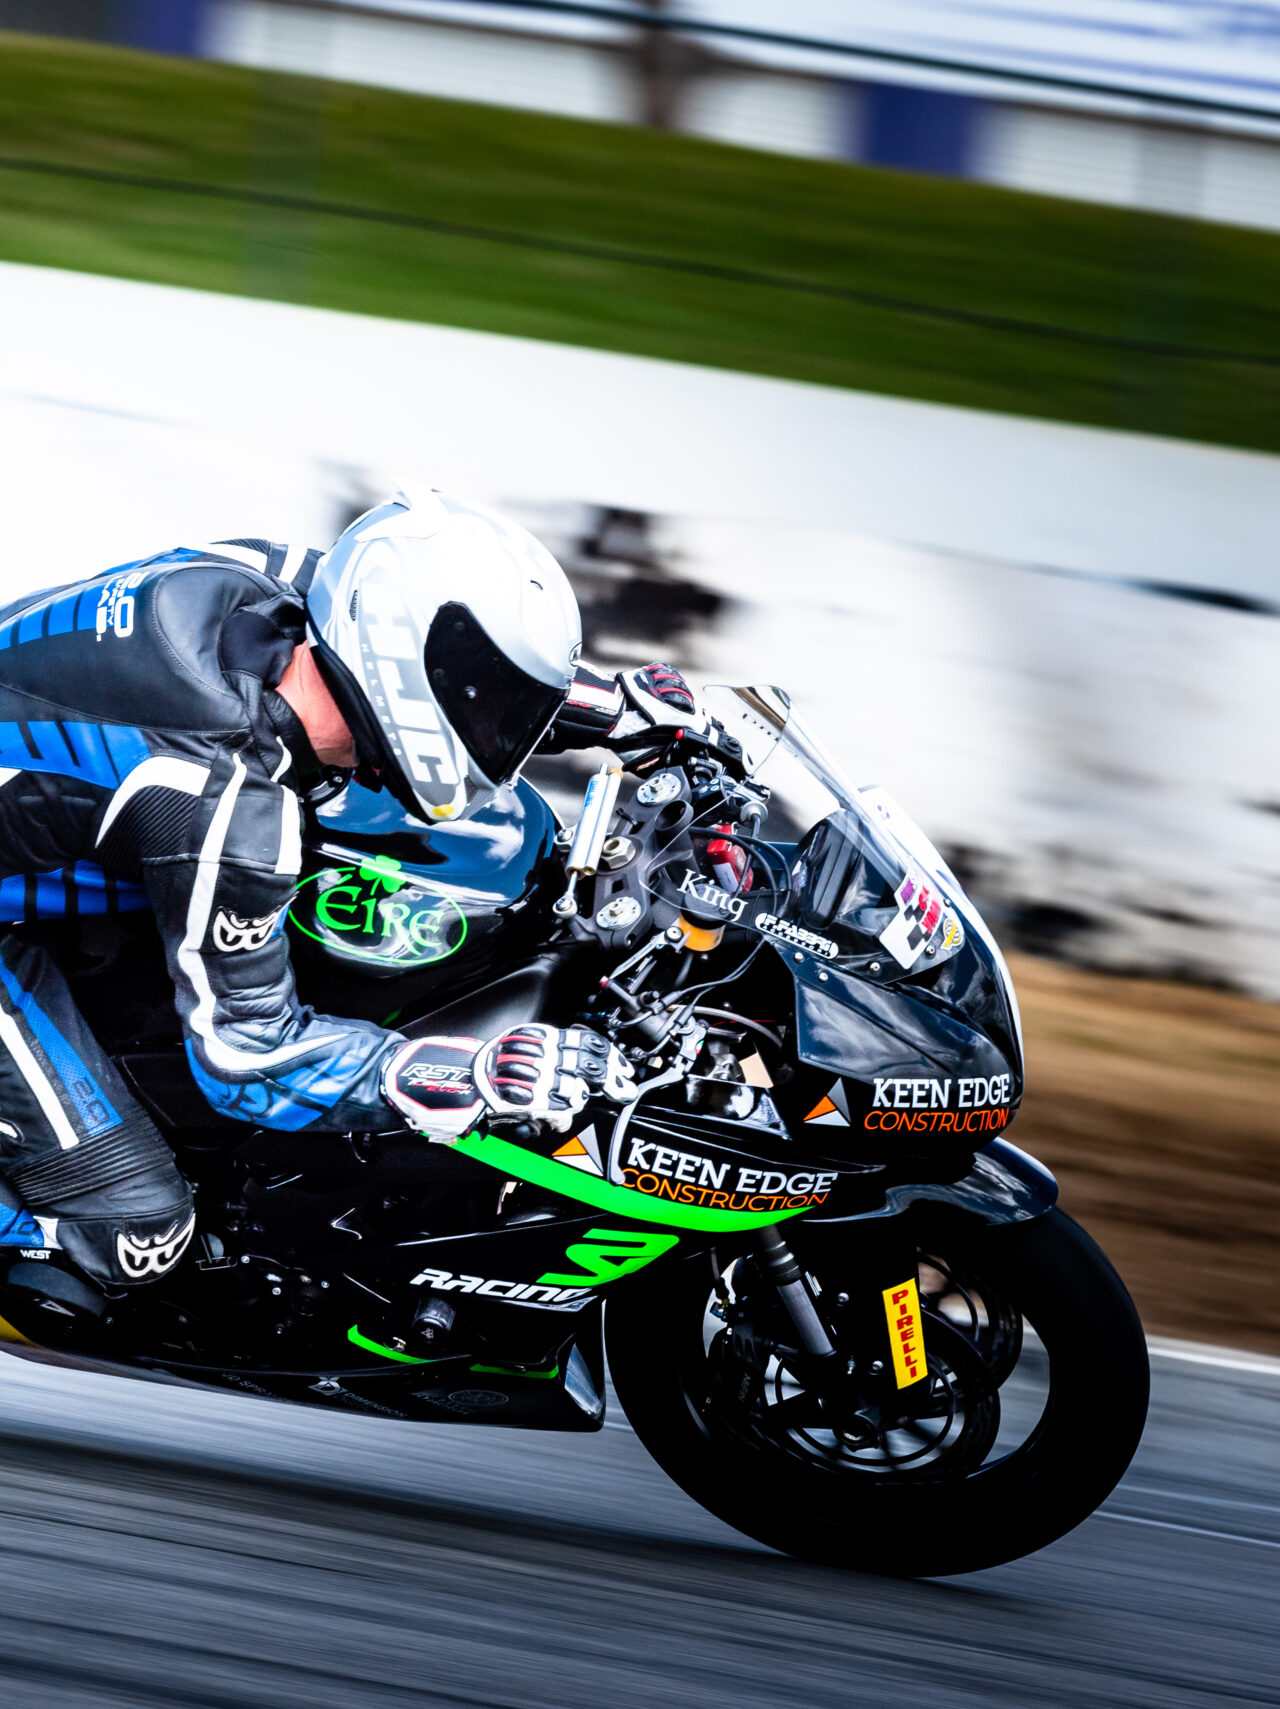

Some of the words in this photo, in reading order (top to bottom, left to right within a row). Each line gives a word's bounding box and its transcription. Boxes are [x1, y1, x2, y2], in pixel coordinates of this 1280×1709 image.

[676, 868, 749, 922] King
[400, 1063, 472, 1081] RST
[872, 1078, 952, 1108] KEEN
[957, 1073, 1011, 1108] EDGE
[863, 1107, 1010, 1132] CONSTRUCTION
[627, 1137, 731, 1190] KEEN
[735, 1167, 838, 1195] EDGE
[621, 1167, 828, 1212] CONSTRUCTION
[409, 1267, 592, 1302] RACING
[891, 1289, 918, 1379] PIRELLI
